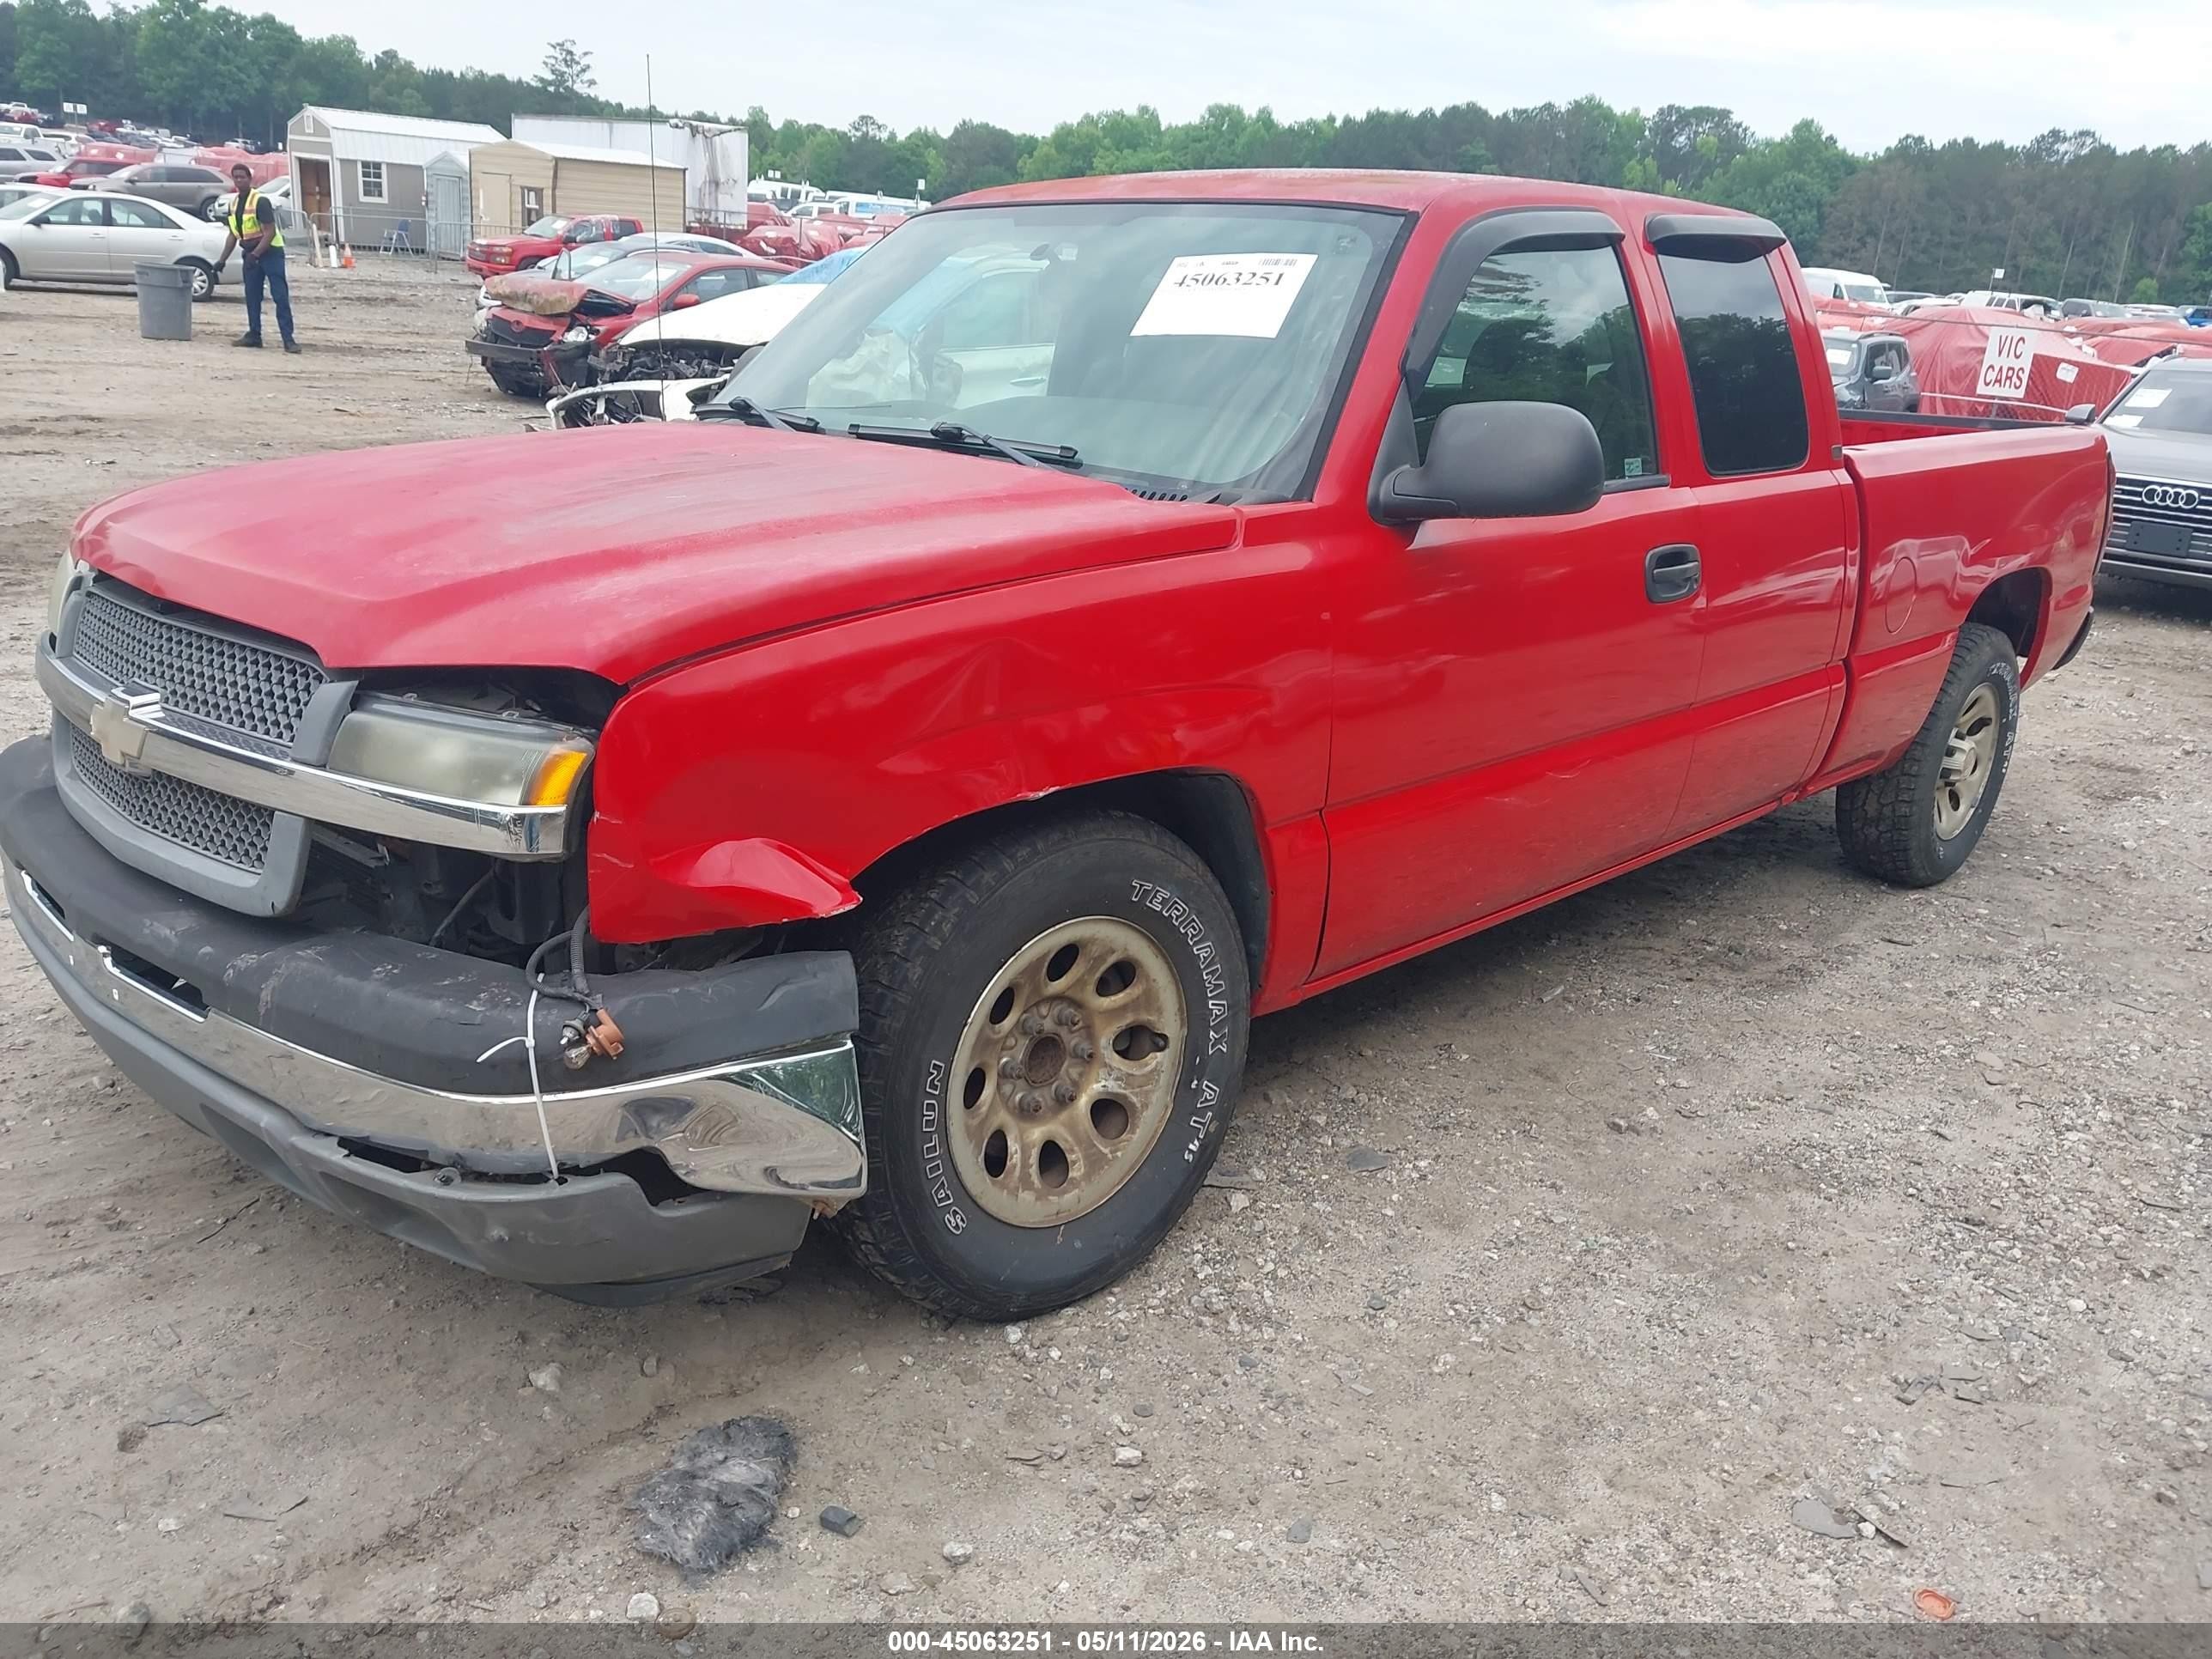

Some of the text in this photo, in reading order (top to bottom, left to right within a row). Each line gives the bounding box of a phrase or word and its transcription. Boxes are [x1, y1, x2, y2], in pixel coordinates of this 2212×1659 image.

[1173, 272, 1285, 288] 45063251
[1997, 334, 2026, 359] VIC
[1984, 363, 2025, 390] CARS
[1131, 878, 1229, 1056] TERRAMAX
[921, 1060, 967, 1236] SAILUN
